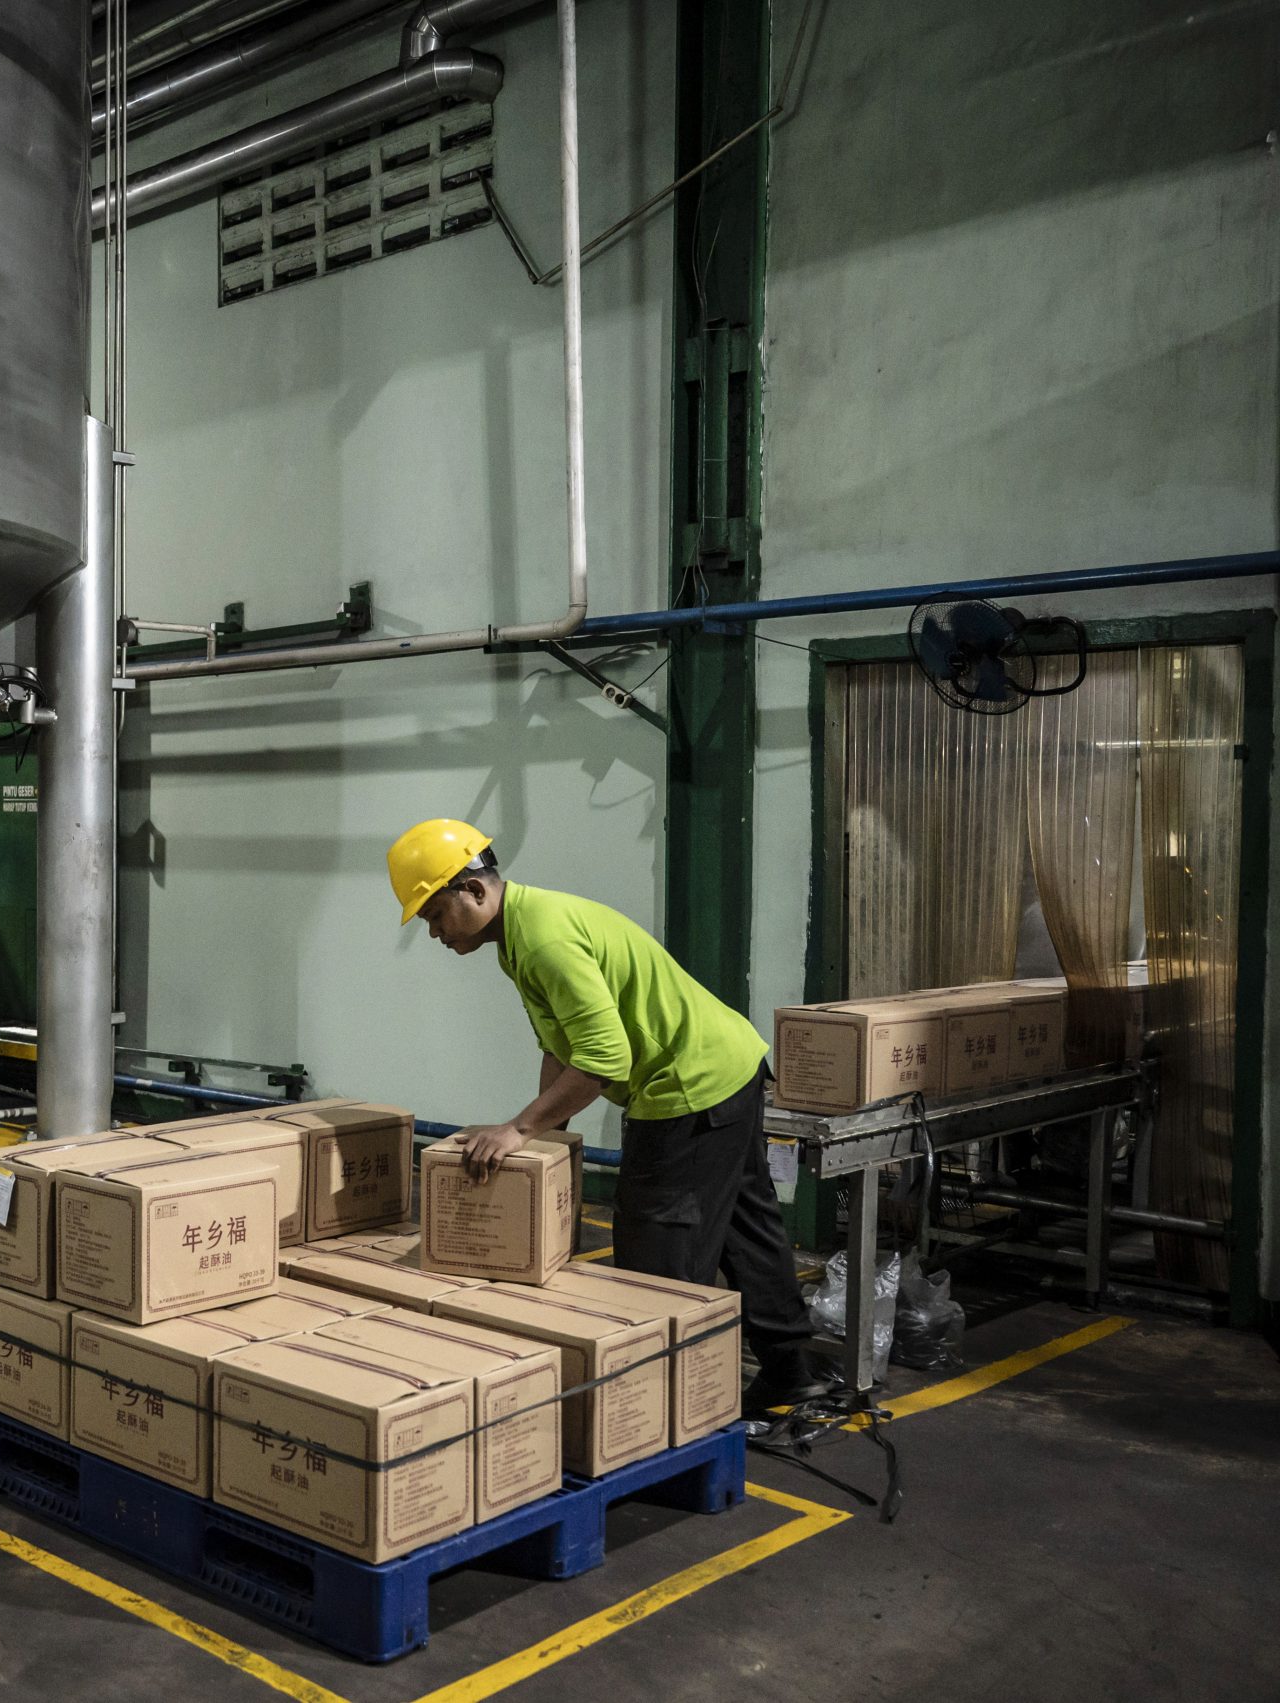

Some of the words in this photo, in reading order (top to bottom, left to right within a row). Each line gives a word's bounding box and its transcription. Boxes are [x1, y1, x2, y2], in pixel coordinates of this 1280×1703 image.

[3, 785, 17, 797] PINTU
[18, 785, 34, 797] GESER
[891, 1043, 928, 1068] 年乡福
[964, 1035, 997, 1058] 年乡福
[341, 1153, 389, 1183] 年乡福
[182, 1215, 247, 1254] 年乡福
[199, 1251, 232, 1270] 起酥油
[116, 1410, 149, 1433] 起酥油
[270, 1464, 309, 1490] 起酥油
